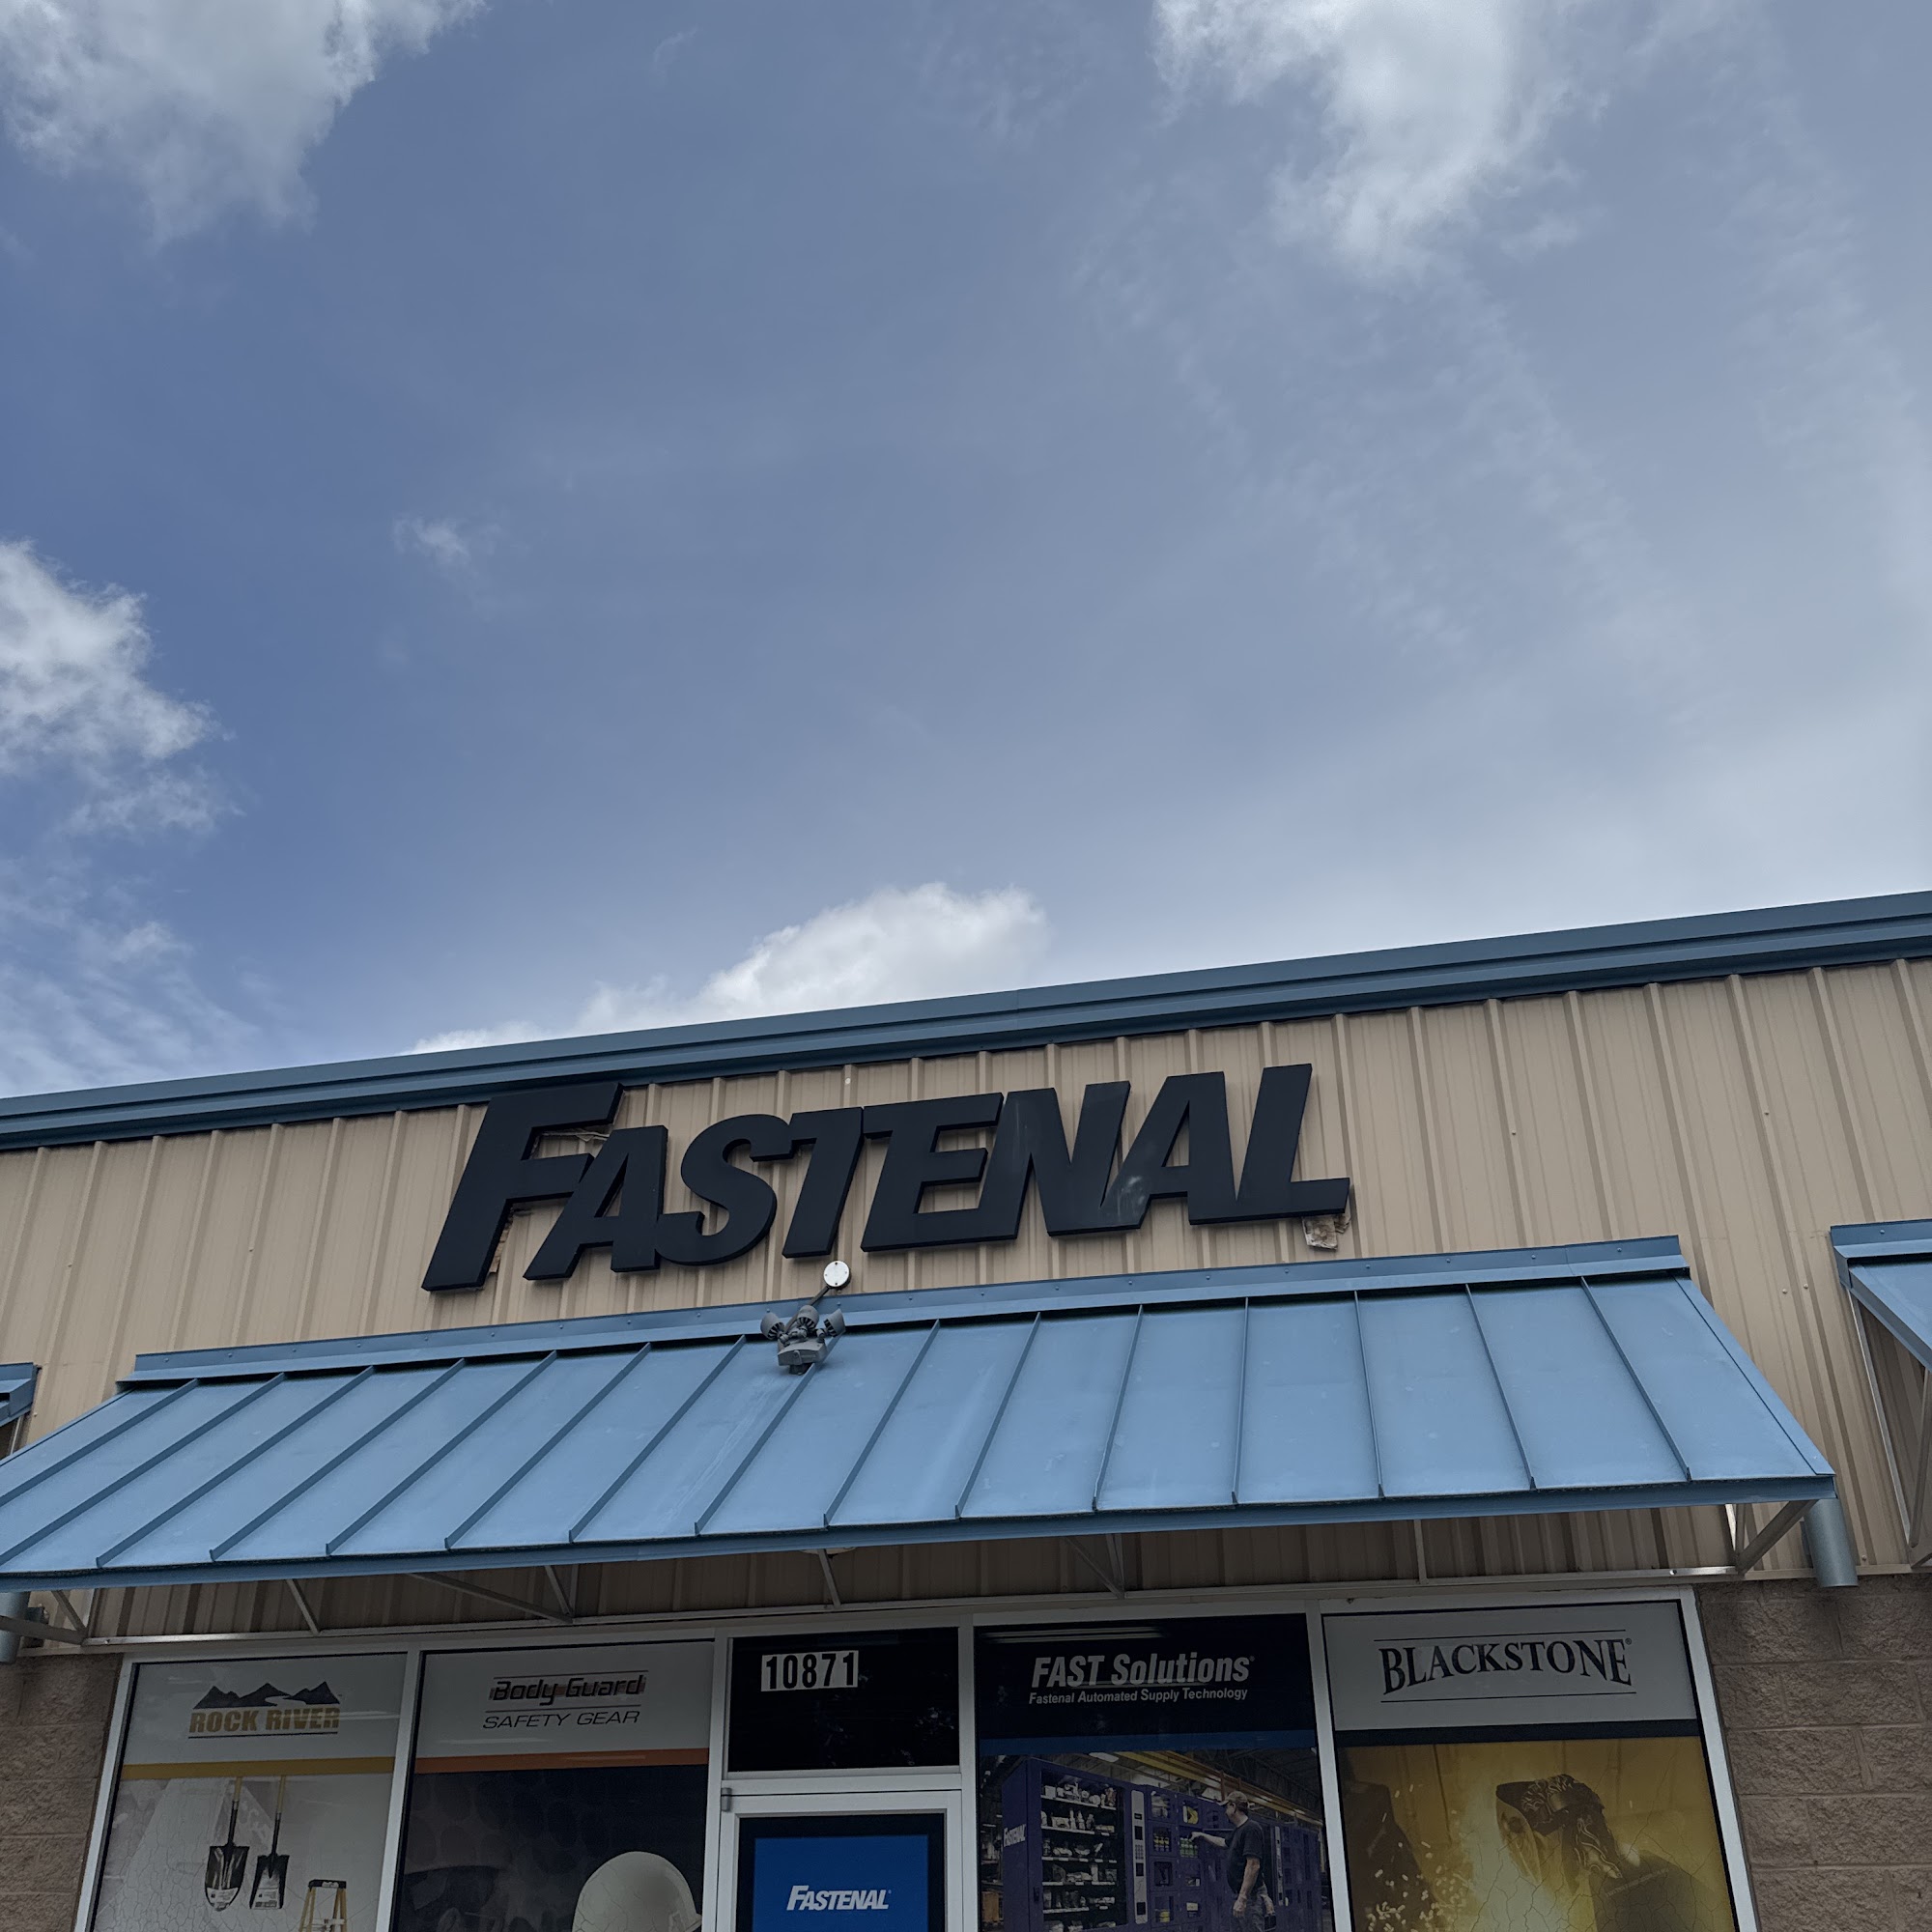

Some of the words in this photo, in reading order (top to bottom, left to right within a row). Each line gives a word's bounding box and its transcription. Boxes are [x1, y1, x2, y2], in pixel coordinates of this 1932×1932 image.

[422, 1064, 1350, 1292] FASTENAL
[766, 1652, 855, 1690] 10871
[1032, 1655, 1106, 1689] FAST
[1111, 1652, 1250, 1686] Solutions
[1378, 1638, 1631, 1695] BLACKSTONE
[493, 1679, 558, 1706] Body
[566, 1674, 644, 1698] Guard
[1029, 1692, 1075, 1704] Fastenal
[1077, 1690, 1138, 1703] Automated
[1140, 1689, 1179, 1703] Supply
[1182, 1687, 1249, 1700] Technology
[189, 1710, 259, 1733] ROCK
[266, 1707, 341, 1730] RIVER
[483, 1713, 571, 1729] SAFETY
[577, 1710, 640, 1725] GEAR
[786, 1885, 890, 1911] FASTENAL
